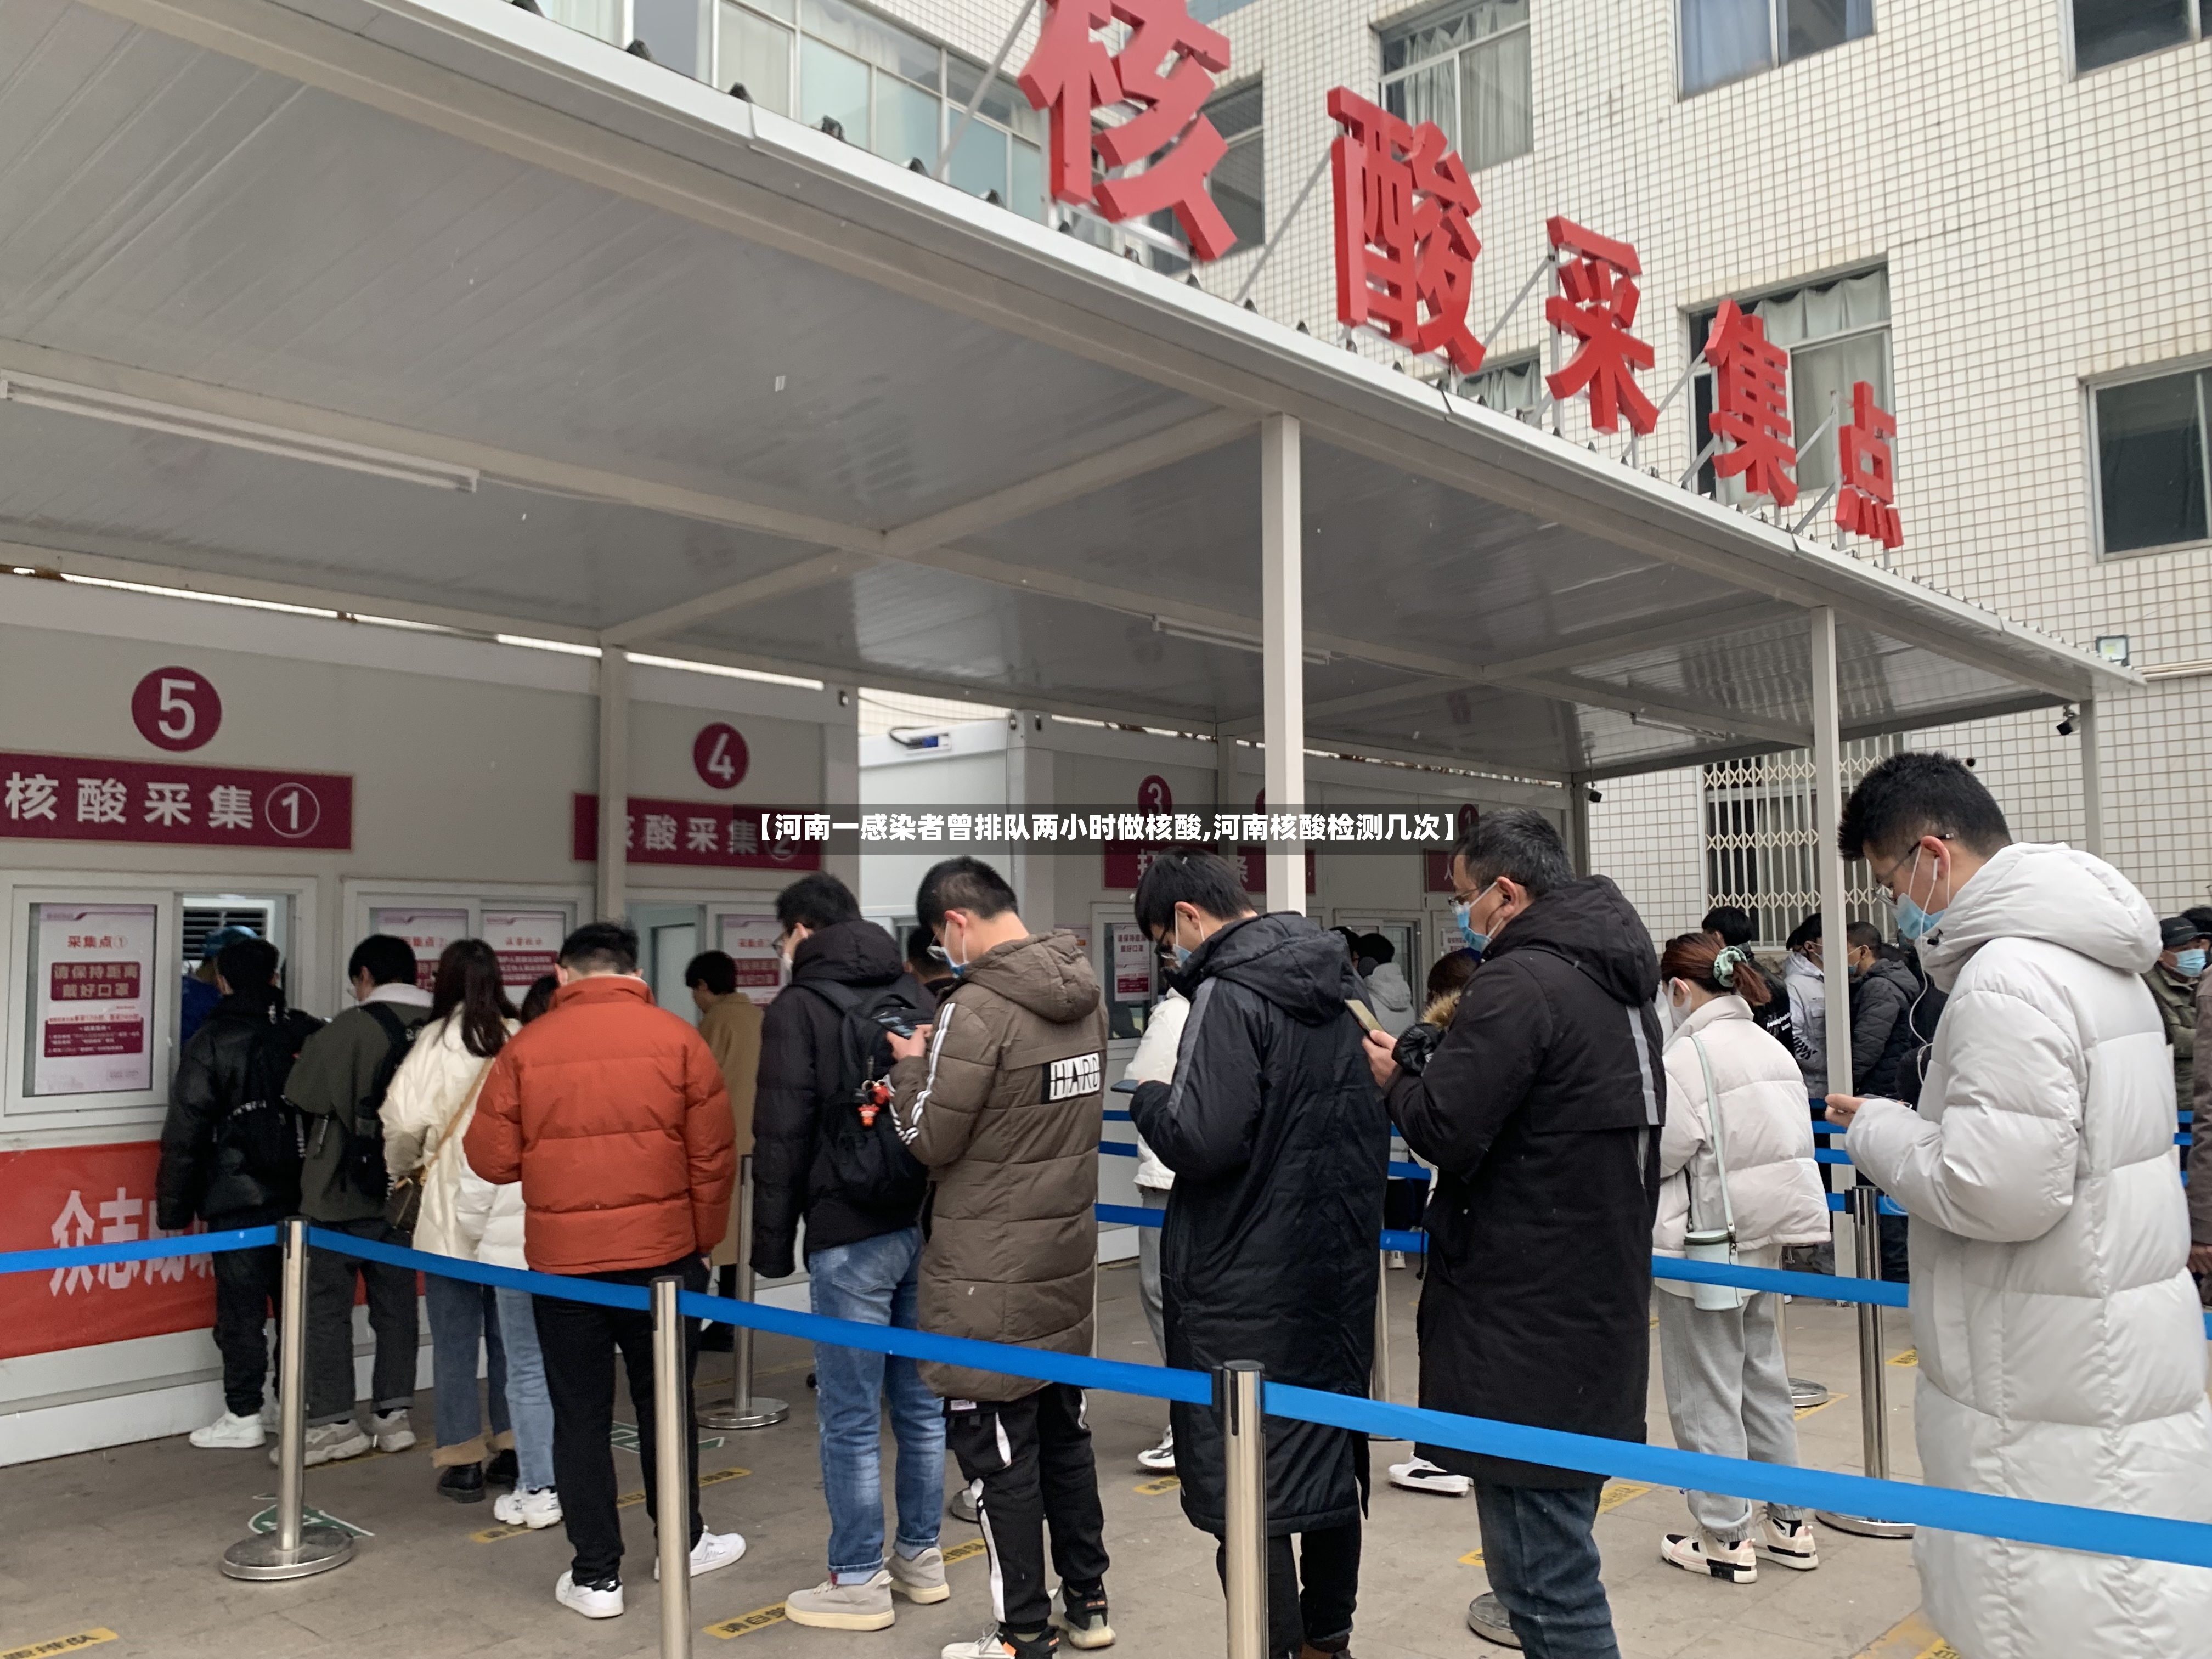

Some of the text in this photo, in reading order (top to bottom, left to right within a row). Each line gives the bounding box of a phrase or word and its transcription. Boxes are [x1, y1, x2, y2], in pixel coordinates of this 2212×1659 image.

[1018, 0, 1904, 548] 核酸采集点
[157, 678, 196, 740] 5
[707, 732, 735, 781] 4
[1148, 783, 1163, 819] 3
[1053, 1057, 1098, 1096] HARD
